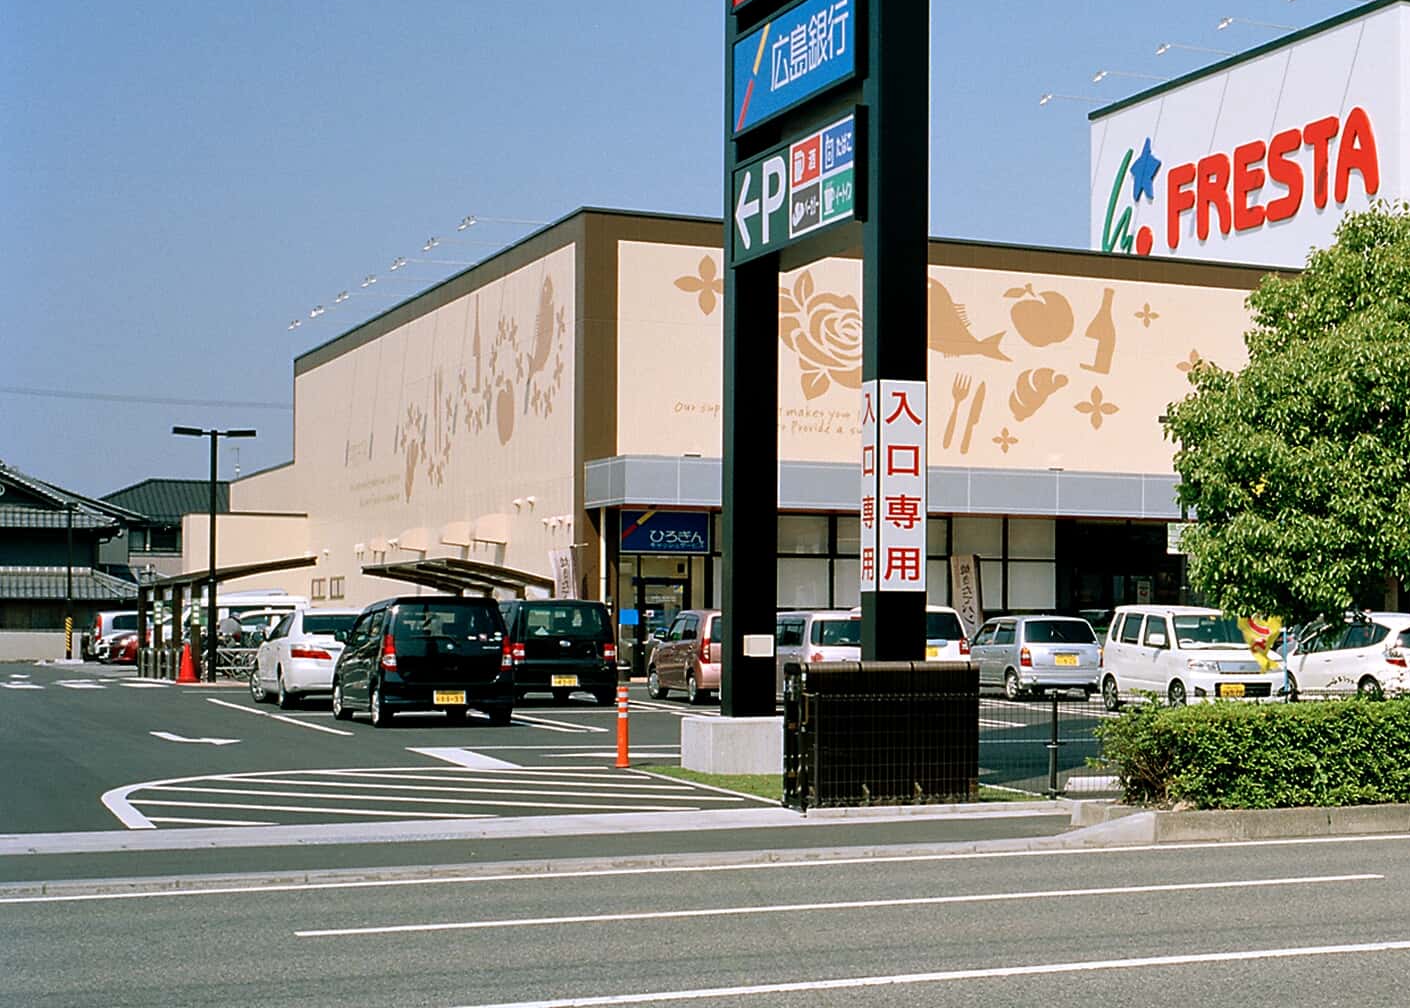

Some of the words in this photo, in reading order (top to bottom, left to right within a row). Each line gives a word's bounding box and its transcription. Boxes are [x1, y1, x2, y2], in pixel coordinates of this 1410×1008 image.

[762, 155, 787, 245] P
[1167, 106, 1379, 250] FRESTA
[649, 530, 704, 544] ひろぎん
[884, 391, 923, 582] 入口専用
